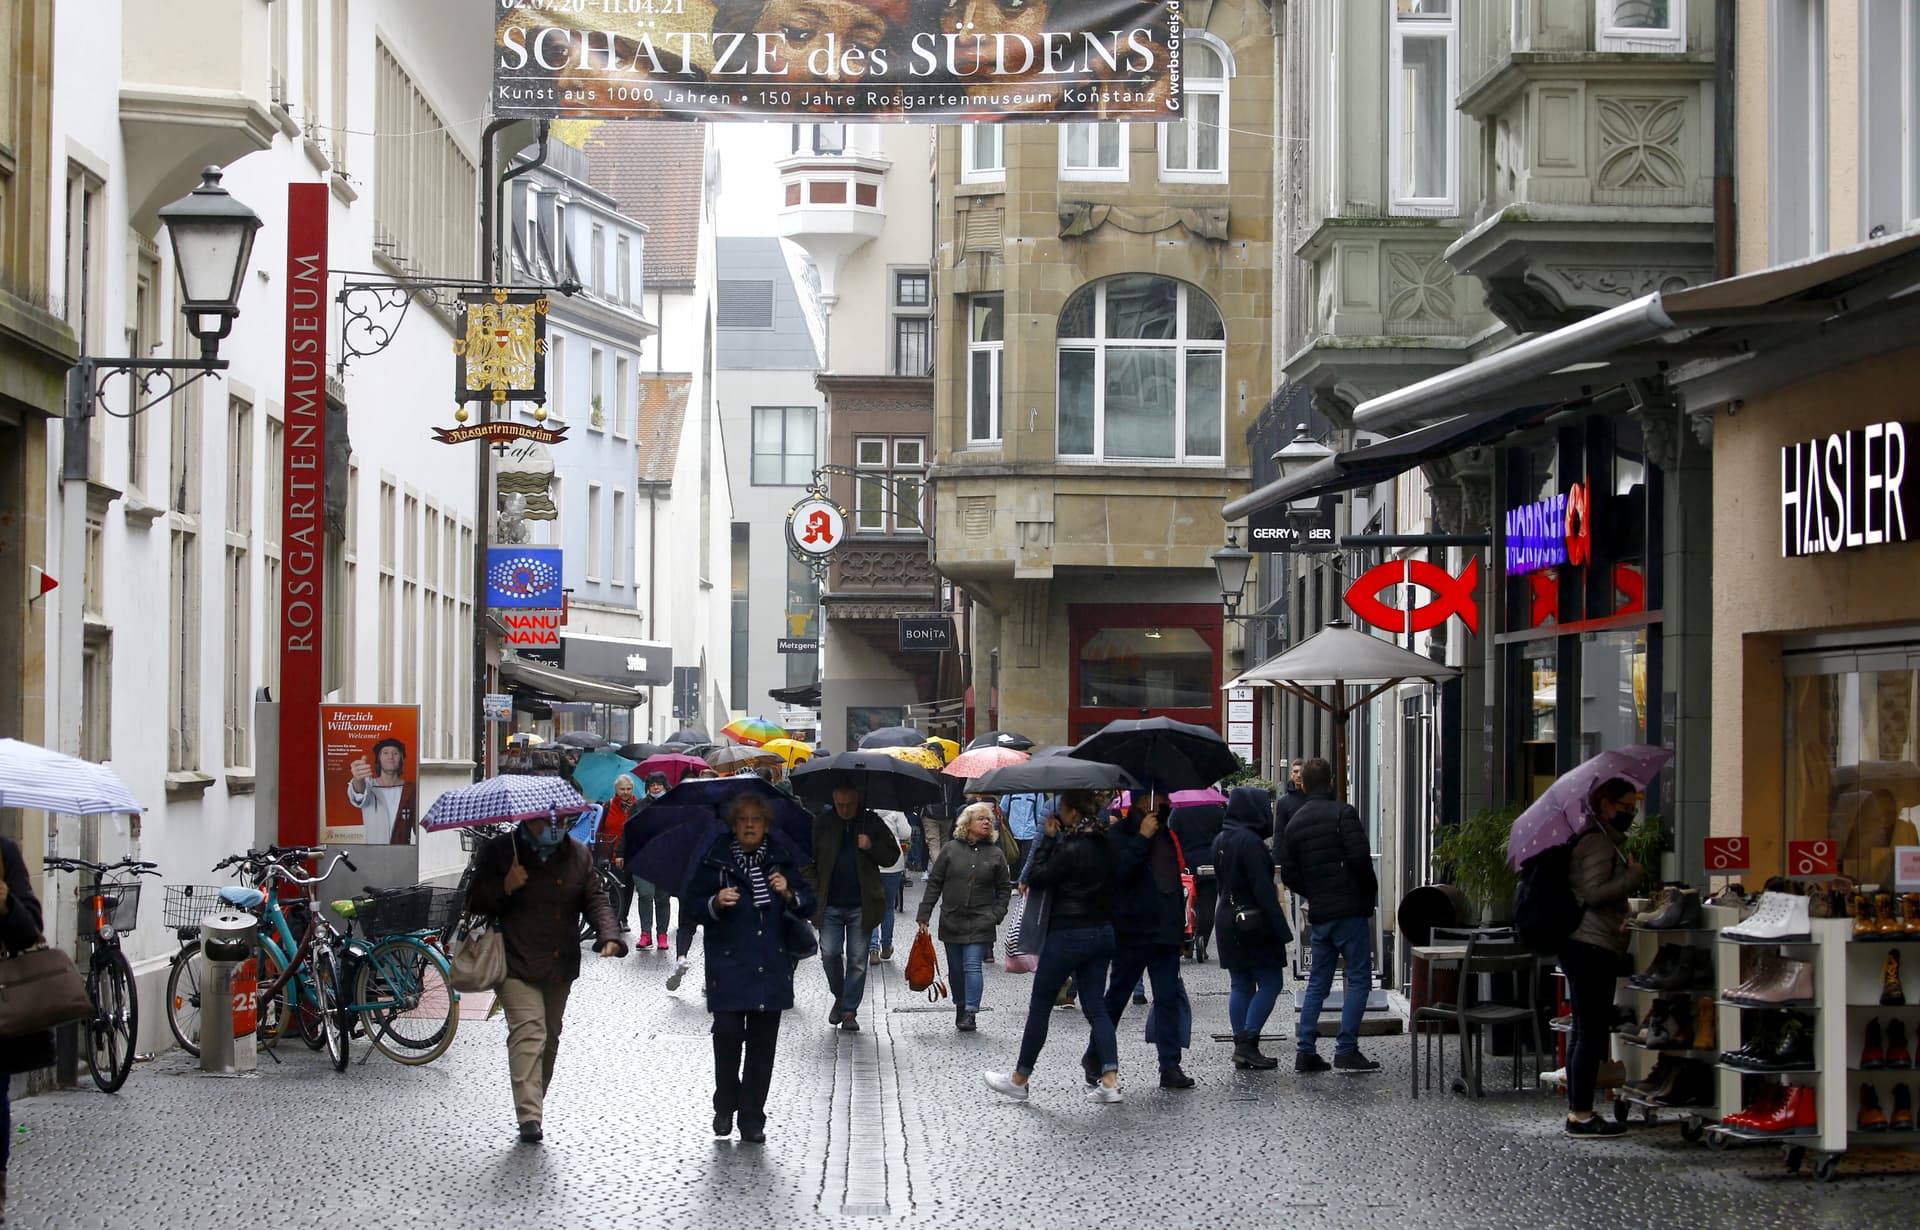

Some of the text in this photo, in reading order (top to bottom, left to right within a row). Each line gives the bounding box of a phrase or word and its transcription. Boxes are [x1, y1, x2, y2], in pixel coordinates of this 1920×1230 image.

[500, 20, 1155, 76] SCHÄTZE des SÜDENS
[500, 86, 1156, 109] Kunst aus 1000 Jahren 150 Jahre Rosgartenmuseum Konstanz
[449, 425, 553, 443] Rosgartenmuseum
[287, 252, 320, 653] ROSGARTENMUSEUM
[1781, 421, 1907, 558] HASLER
[1253, 528, 1331, 539] GERRY WBER
[504, 615, 558, 629] NANU
[504, 631, 559, 645] NANA
[779, 641, 817, 651] Metzgerei
[1237, 690, 1245, 699] 14
[333, 711, 374, 721] Herzlich
[328, 722, 393, 731] Willkommen!
[1713, 838, 1742, 869] %
[1798, 841, 1828, 874] %
